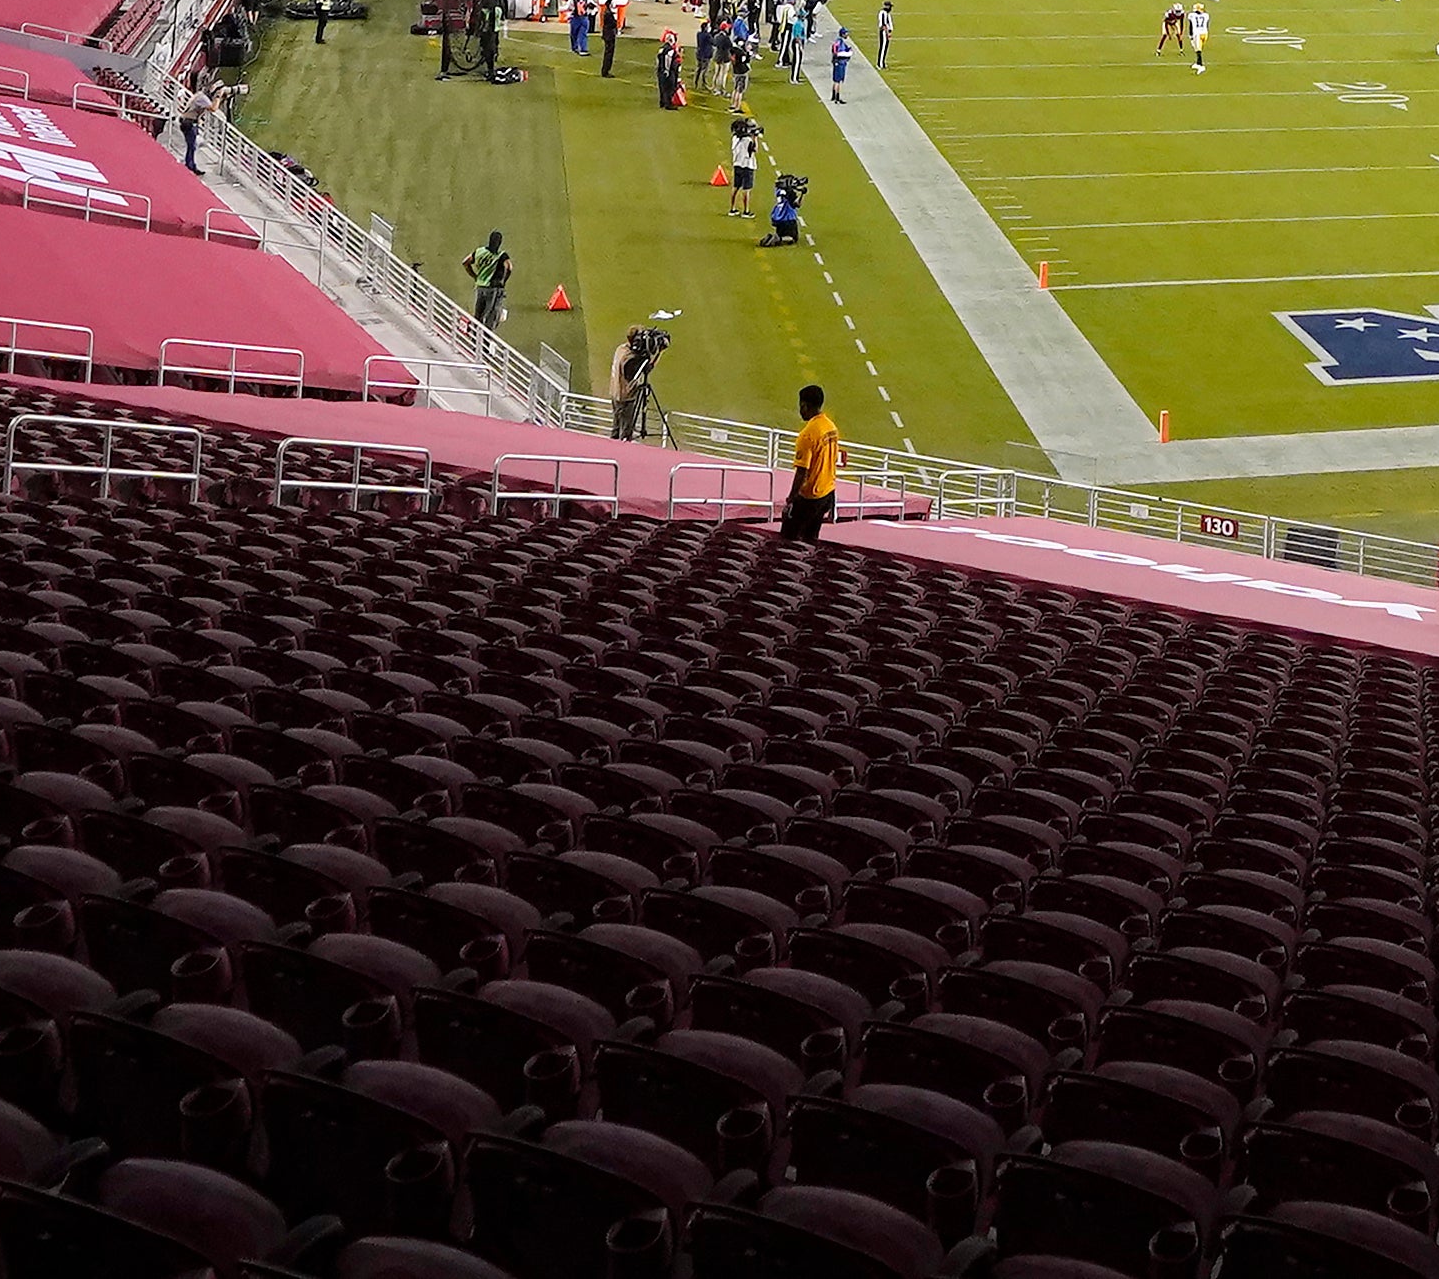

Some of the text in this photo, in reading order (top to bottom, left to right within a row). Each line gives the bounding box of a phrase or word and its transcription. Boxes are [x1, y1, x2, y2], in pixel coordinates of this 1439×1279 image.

[1193, 15, 1207, 29] 17
[1312, 80, 1410, 112] 20
[1201, 516, 1240, 538] 130
[869, 519, 1438, 623] yahoo!
